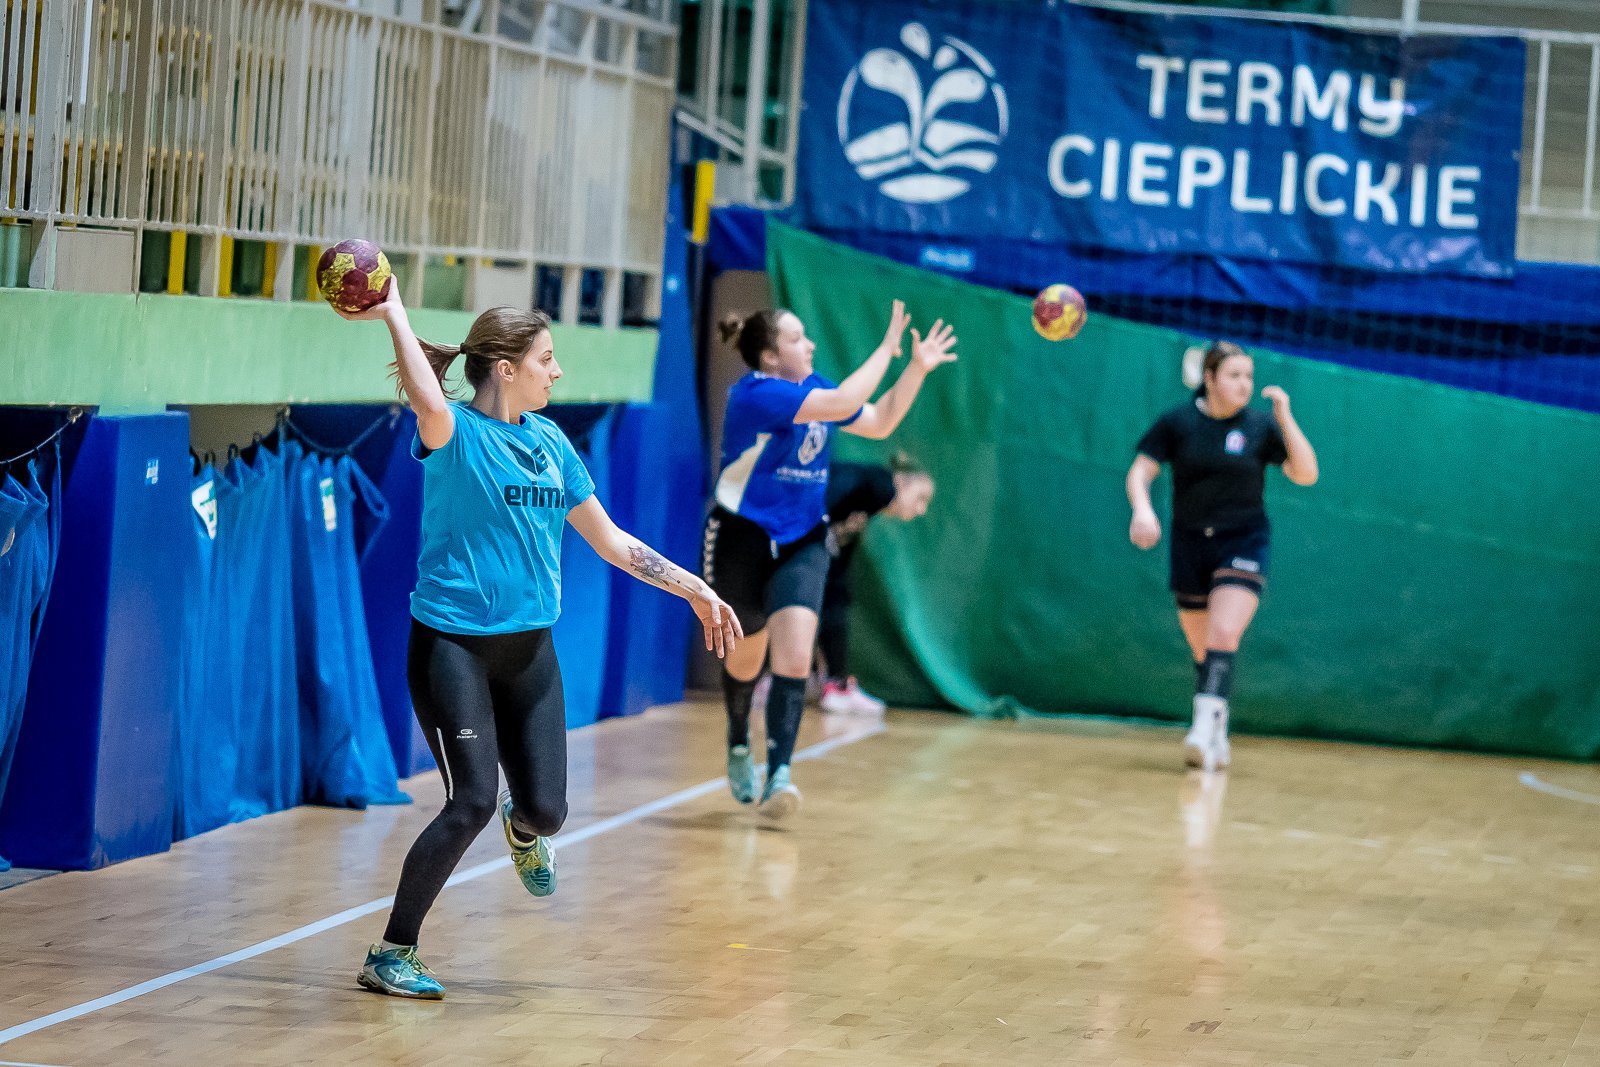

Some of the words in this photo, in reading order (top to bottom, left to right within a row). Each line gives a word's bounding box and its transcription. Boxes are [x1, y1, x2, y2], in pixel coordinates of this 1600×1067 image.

[1137, 54, 1407, 137] TERMY
[1048, 134, 1482, 230] CIEPLICKIE
[504, 480, 565, 509] erim
